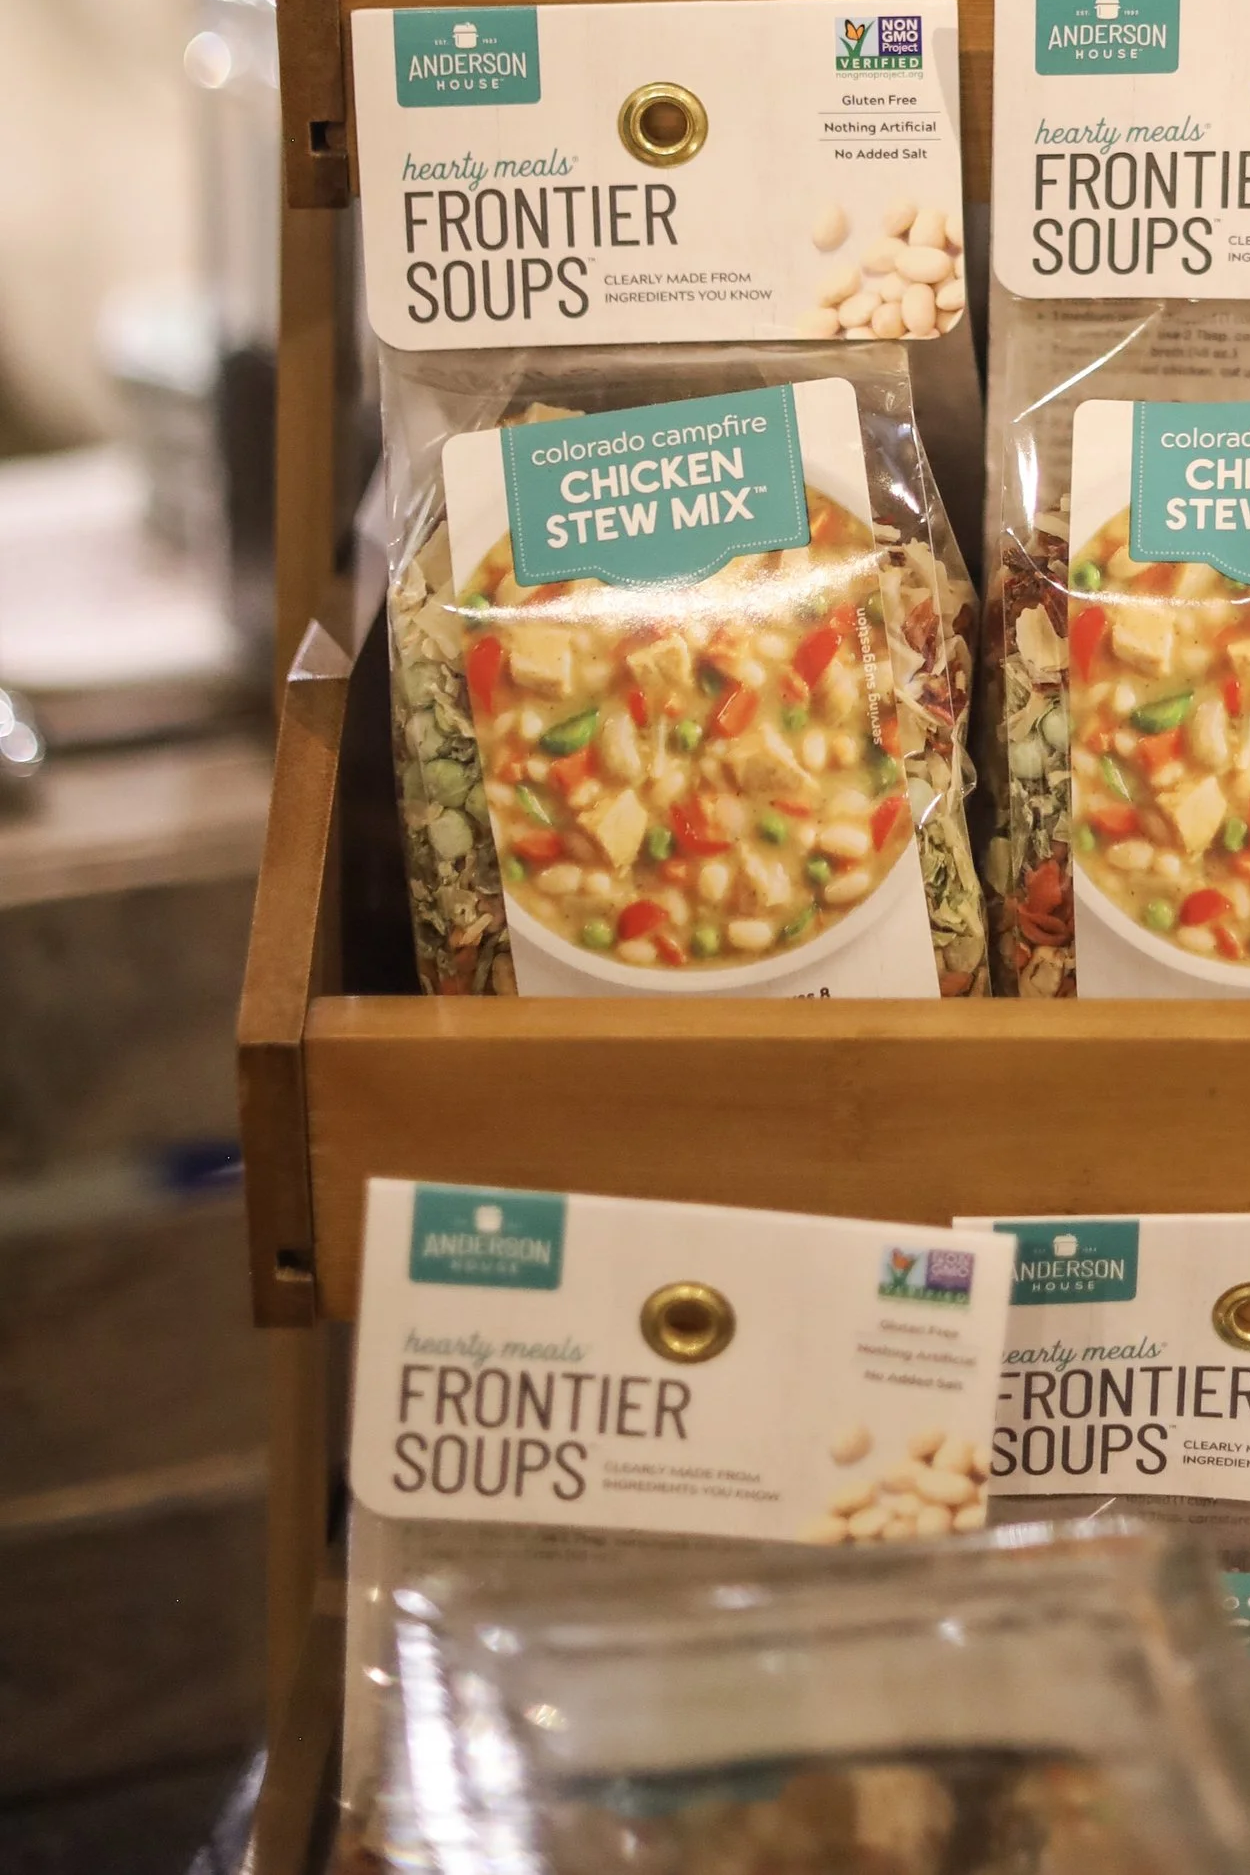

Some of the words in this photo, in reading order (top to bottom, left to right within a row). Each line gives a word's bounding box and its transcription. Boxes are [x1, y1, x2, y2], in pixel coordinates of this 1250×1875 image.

[882, 19, 918, 31] NON
[882, 31, 918, 42] GMO
[1048, 24, 1167, 50] ANDERSON
[882, 43, 918, 54] Project
[1076, 49, 1138, 60] HOUSE
[408, 52, 527, 82] ANDERSON
[836, 71, 924, 80] nongmoproject.org
[841, 58, 919, 69] VERIFIED
[436, 79, 500, 91] HOUSE
[842, 95, 885, 106] Gluten
[889, 95, 917, 105] Free
[825, 122, 876, 135] Nothing
[880, 121, 936, 133] Artificial
[1035, 117, 1122, 155] hearty
[835, 150, 852, 159] No
[857, 149, 899, 159] Added
[903, 149, 927, 159] Salt
[402, 151, 488, 191] hearty
[404, 184, 678, 253] FRONTIER
[604, 273, 663, 286] CLEARLY
[668, 273, 708, 284] MADE
[711, 272, 751, 283] FROM
[605, 291, 695, 303] INGREDIENTS
[699, 291, 726, 302] YOU
[730, 289, 772, 301] KNOW
[531, 431, 645, 466] colorado
[651, 414, 768, 448] campfire
[560, 447, 745, 504] CHICKEN
[546, 501, 658, 549] STEW
[856, 607, 877, 690] suggestion
[867, 692, 882, 746] serving
[422, 1233, 551, 1265] ANDERSON
[1032, 1281, 1095, 1292] HOUSE
[404, 1327, 495, 1369] hearty
[501, 1334, 586, 1362] meals
[1002, 1340, 1077, 1372] earty
[399, 1364, 692, 1441] FRONTIER
[1183, 1440, 1242, 1453] CLEARLY
[392, 1431, 588, 1501] SOUPS
